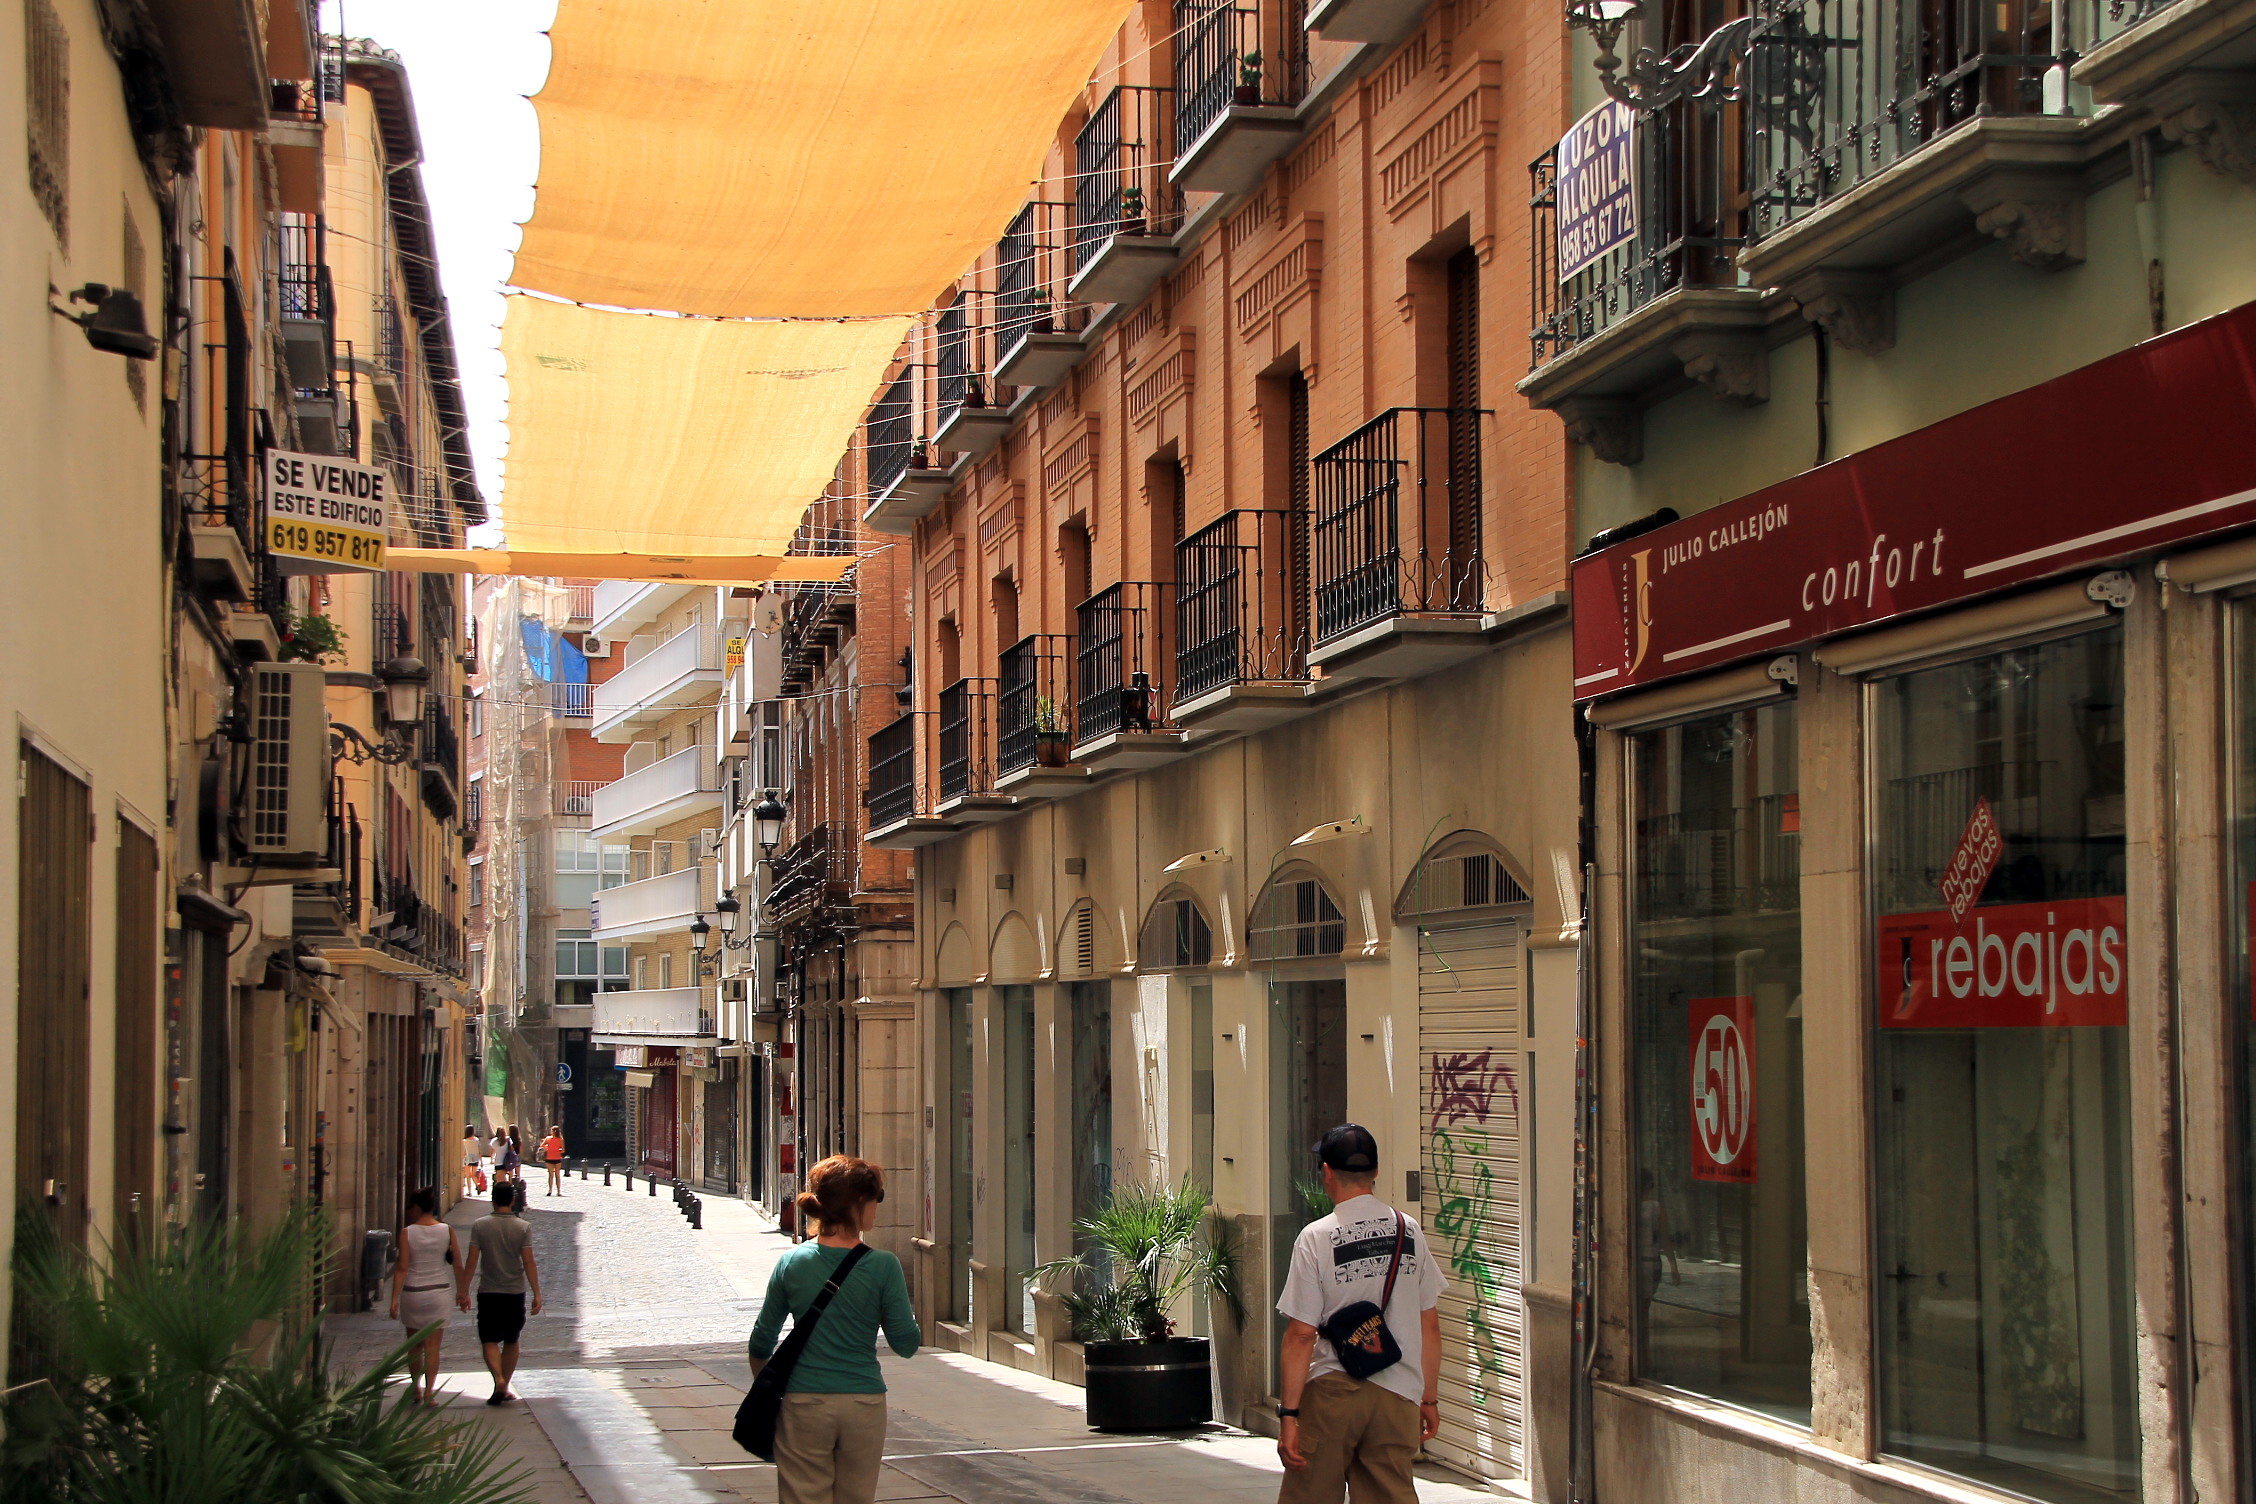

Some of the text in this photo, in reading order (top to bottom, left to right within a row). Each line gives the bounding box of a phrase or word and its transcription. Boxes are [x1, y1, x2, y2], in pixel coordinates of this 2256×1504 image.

[1561, 140, 1630, 229] ALQUILA
[1562, 191, 1632, 272] 958 53 67 72
[274, 458, 384, 502] SE VENDE
[274, 491, 382, 527] ESTE EDIFICIO
[273, 524, 382, 563] 619 957 817
[1662, 502, 1789, 574] JULIO CALLEJÓN
[1802, 528, 1944, 612] confort
[1942, 807, 1989, 902] nuevas
[1950, 829, 1998, 924] rebajas
[1931, 911, 2120, 1015] rebajas
[1348, 1314, 1382, 1347] SWEET YEARS
